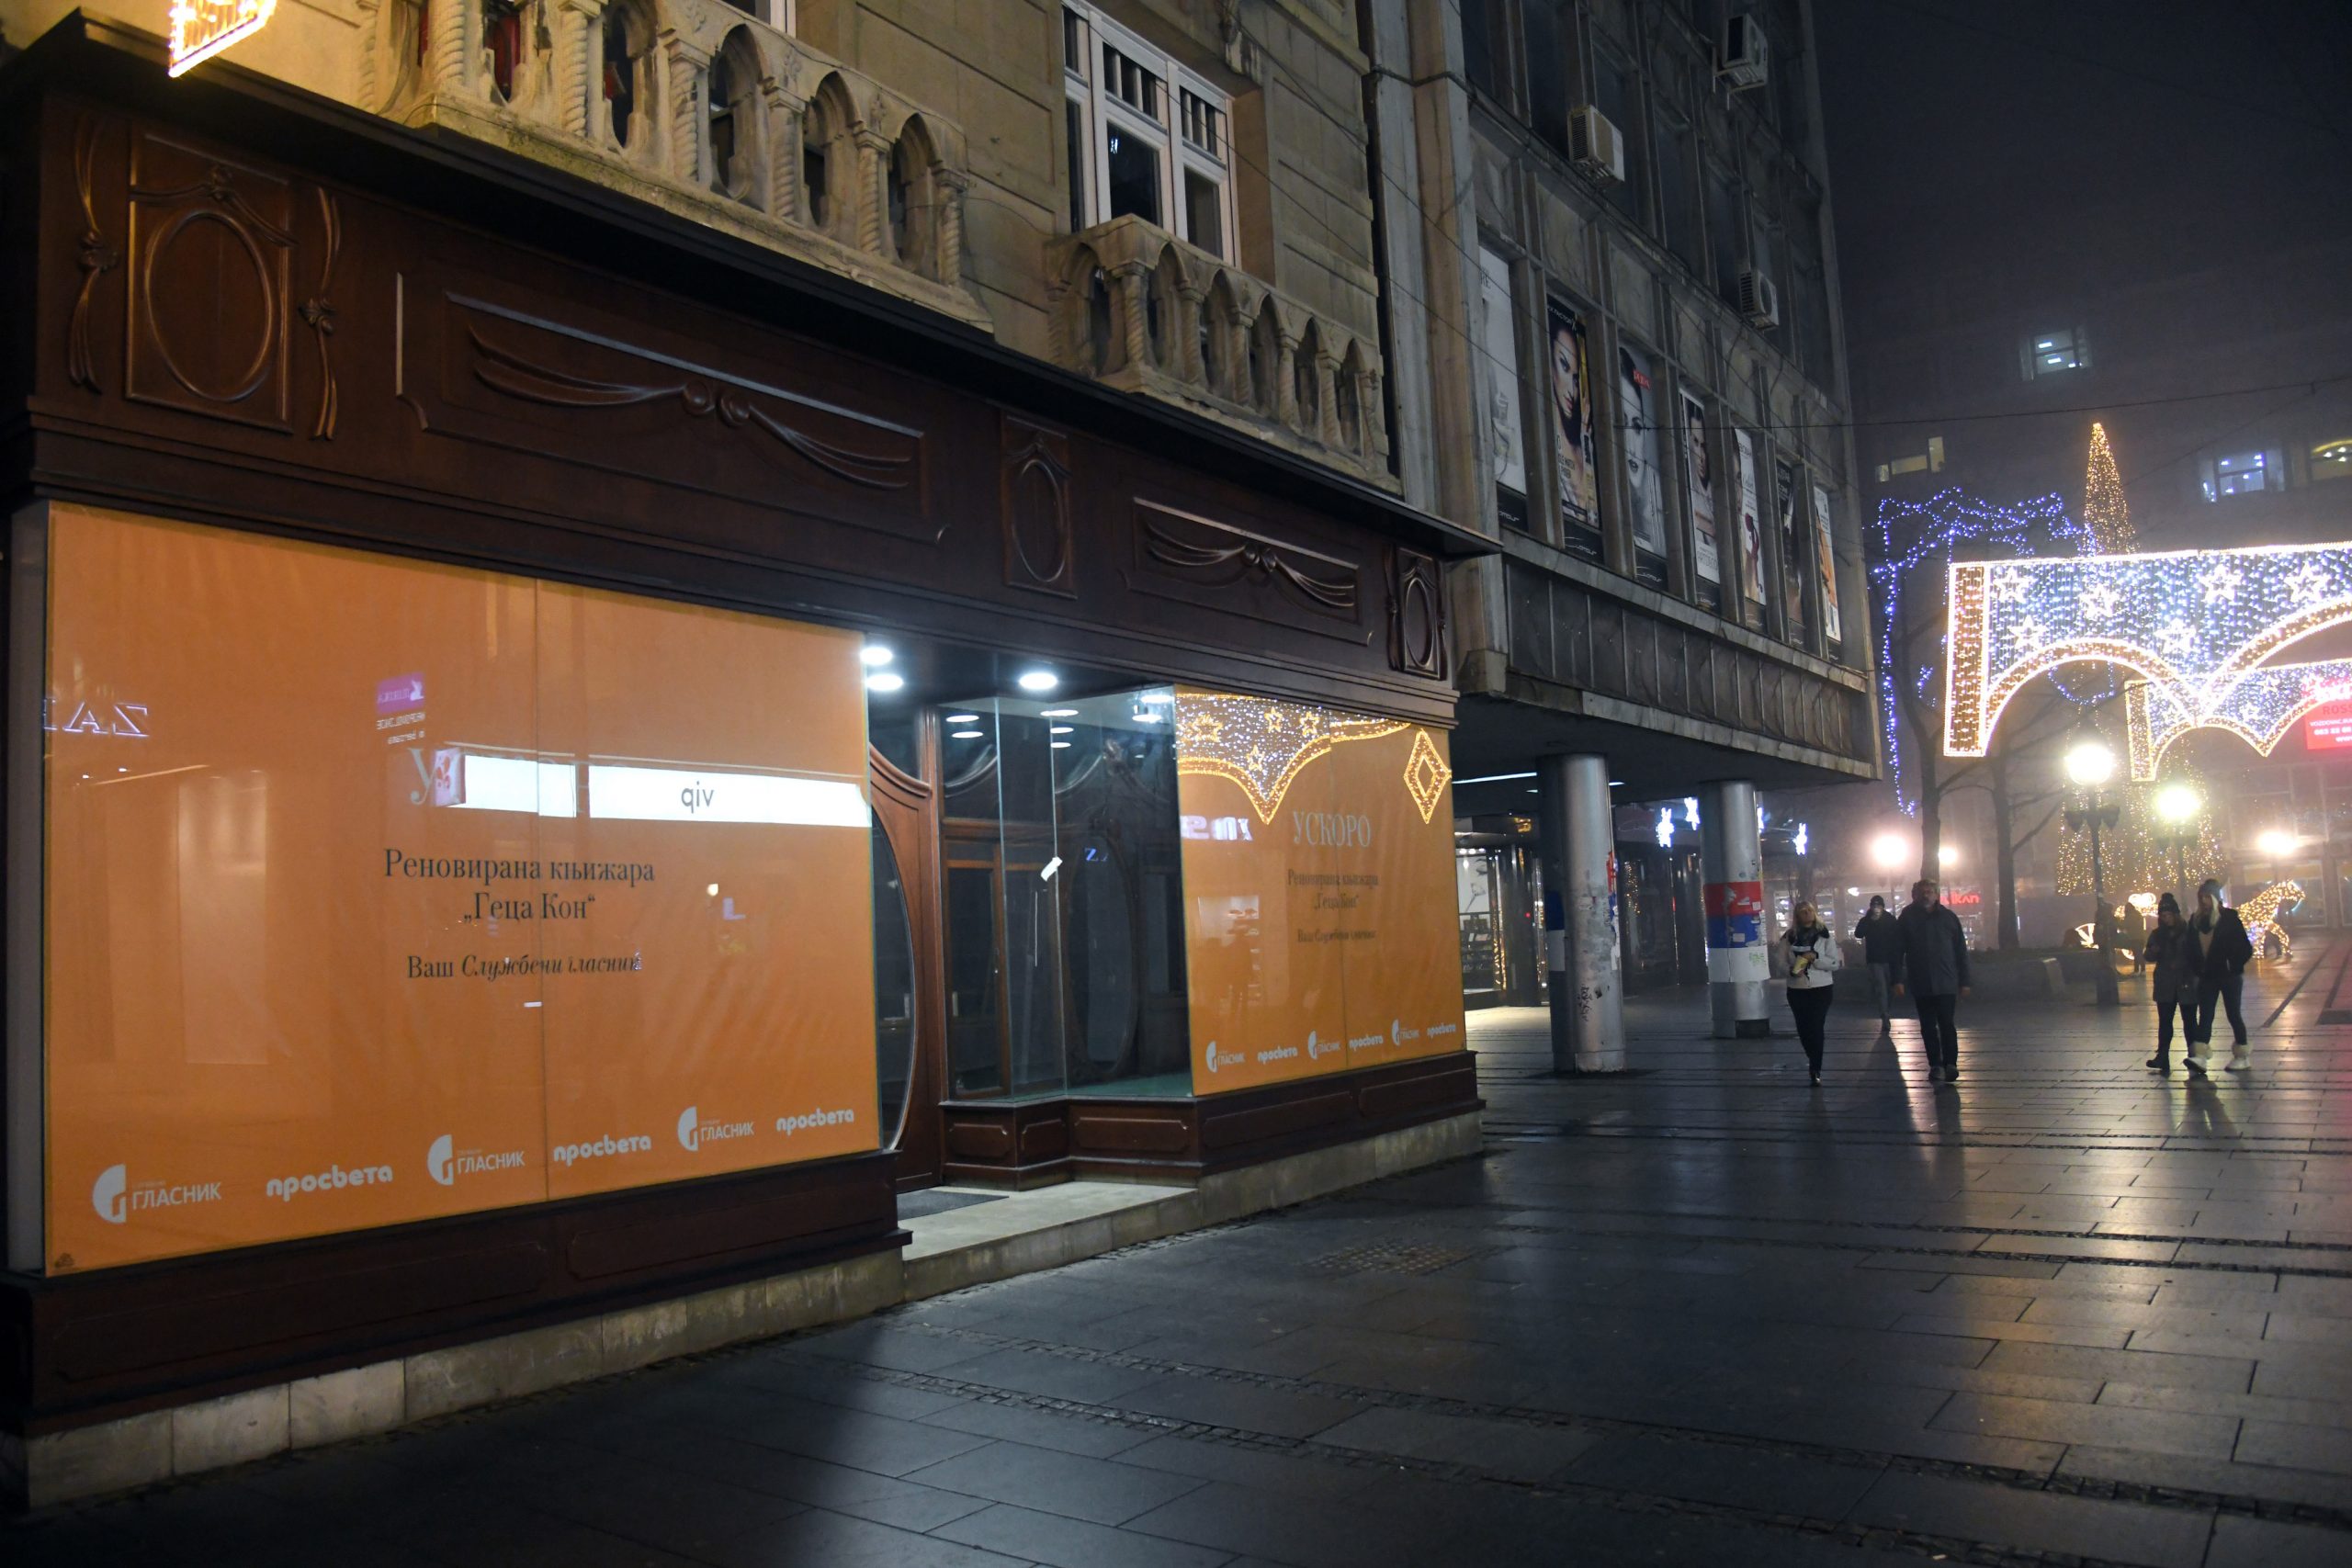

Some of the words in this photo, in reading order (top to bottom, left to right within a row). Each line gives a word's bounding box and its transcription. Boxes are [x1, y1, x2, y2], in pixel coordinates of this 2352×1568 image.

[1292, 810, 1373, 848] УСКОРО
[384, 848, 541, 886] Реновирана
[550, 862, 655, 887] књижара
[463, 892, 533, 924] „Геца
[541, 892, 596, 919] Кон“
[407, 955, 454, 979] Ваш
[461, 953, 562, 982] Службени
[700, 1122, 755, 1142] ГЛАСНИК
[457, 1150, 526, 1175] ГЛАСНИК
[131, 1181, 222, 1211] ГЛАСНИК
